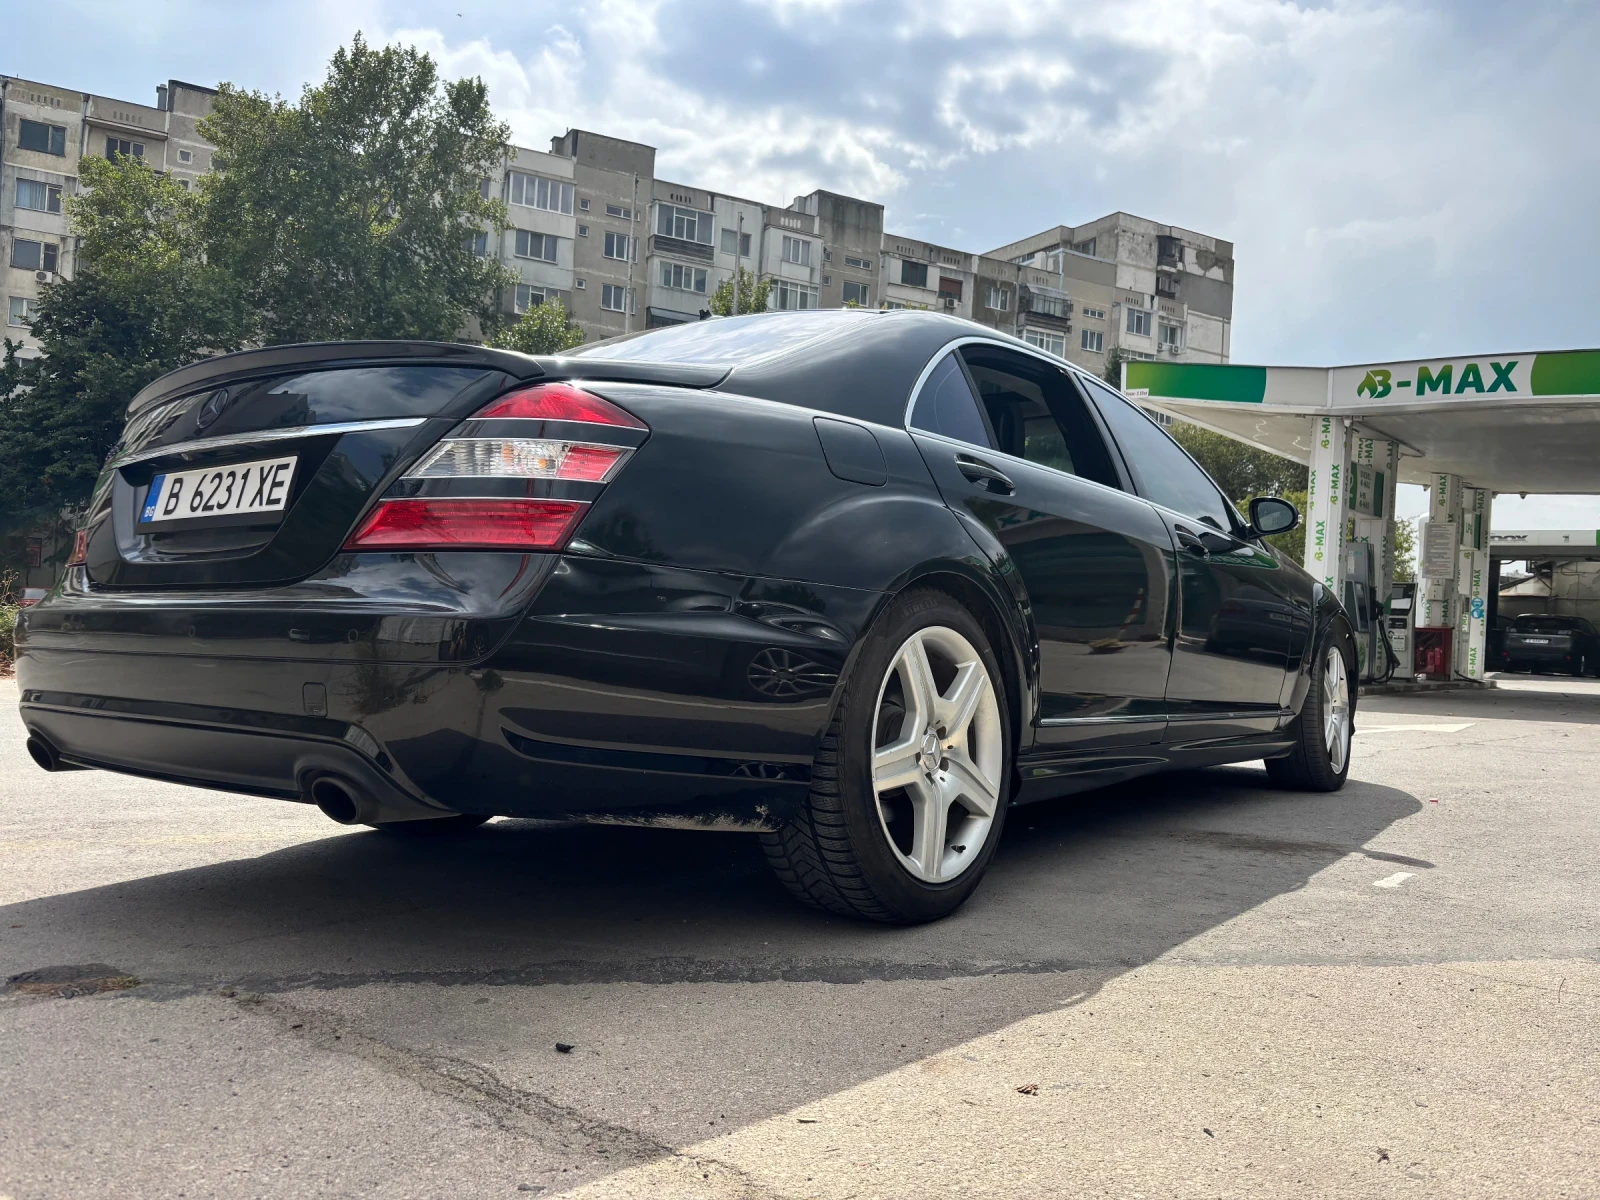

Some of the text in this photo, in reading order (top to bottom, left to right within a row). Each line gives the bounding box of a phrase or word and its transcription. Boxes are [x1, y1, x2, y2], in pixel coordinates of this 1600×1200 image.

[1357, 361, 1519, 398] B-MAX
[1321, 417, 1331, 449] B-MA
[163, 478, 183, 515] B
[190, 468, 251, 512] 6231
[249, 463, 291, 508] XE
[1330, 464, 1340, 505] B-MAX
[1439, 475, 1447, 506] B-MAX
[1477, 491, 1485, 511] -MAX
[1315, 521, 1325, 561] B-MAX
[1469, 647, 1477, 676] B-MAX
